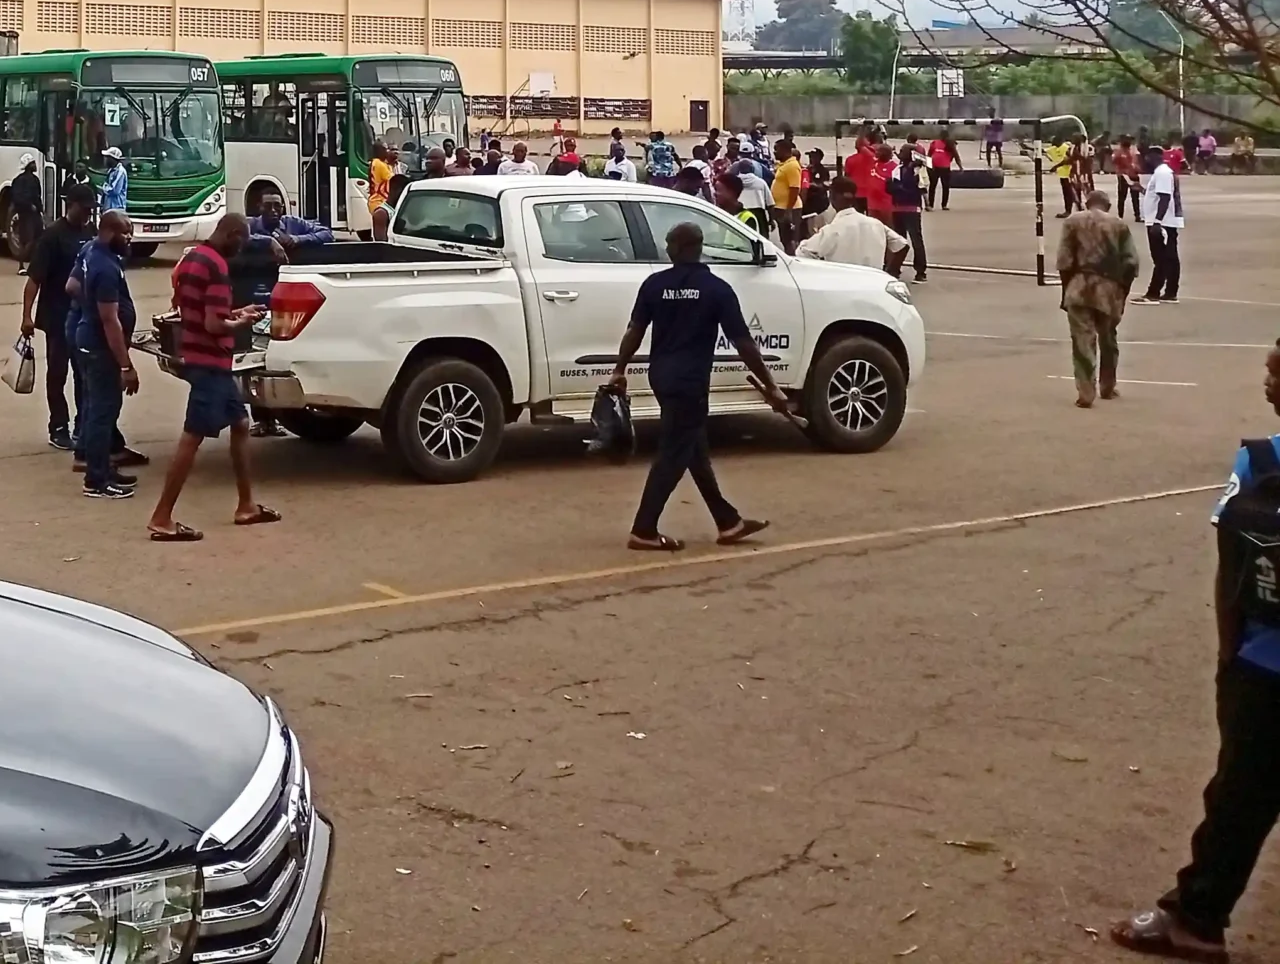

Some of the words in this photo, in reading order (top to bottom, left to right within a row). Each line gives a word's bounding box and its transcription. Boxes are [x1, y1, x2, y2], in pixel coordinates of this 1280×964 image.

[190, 67, 209, 81] 057
[440, 69, 455, 82] 060
[107, 109, 118, 123] 7
[379, 106, 388, 120] 8
[560, 369, 588, 377] BUSES,
